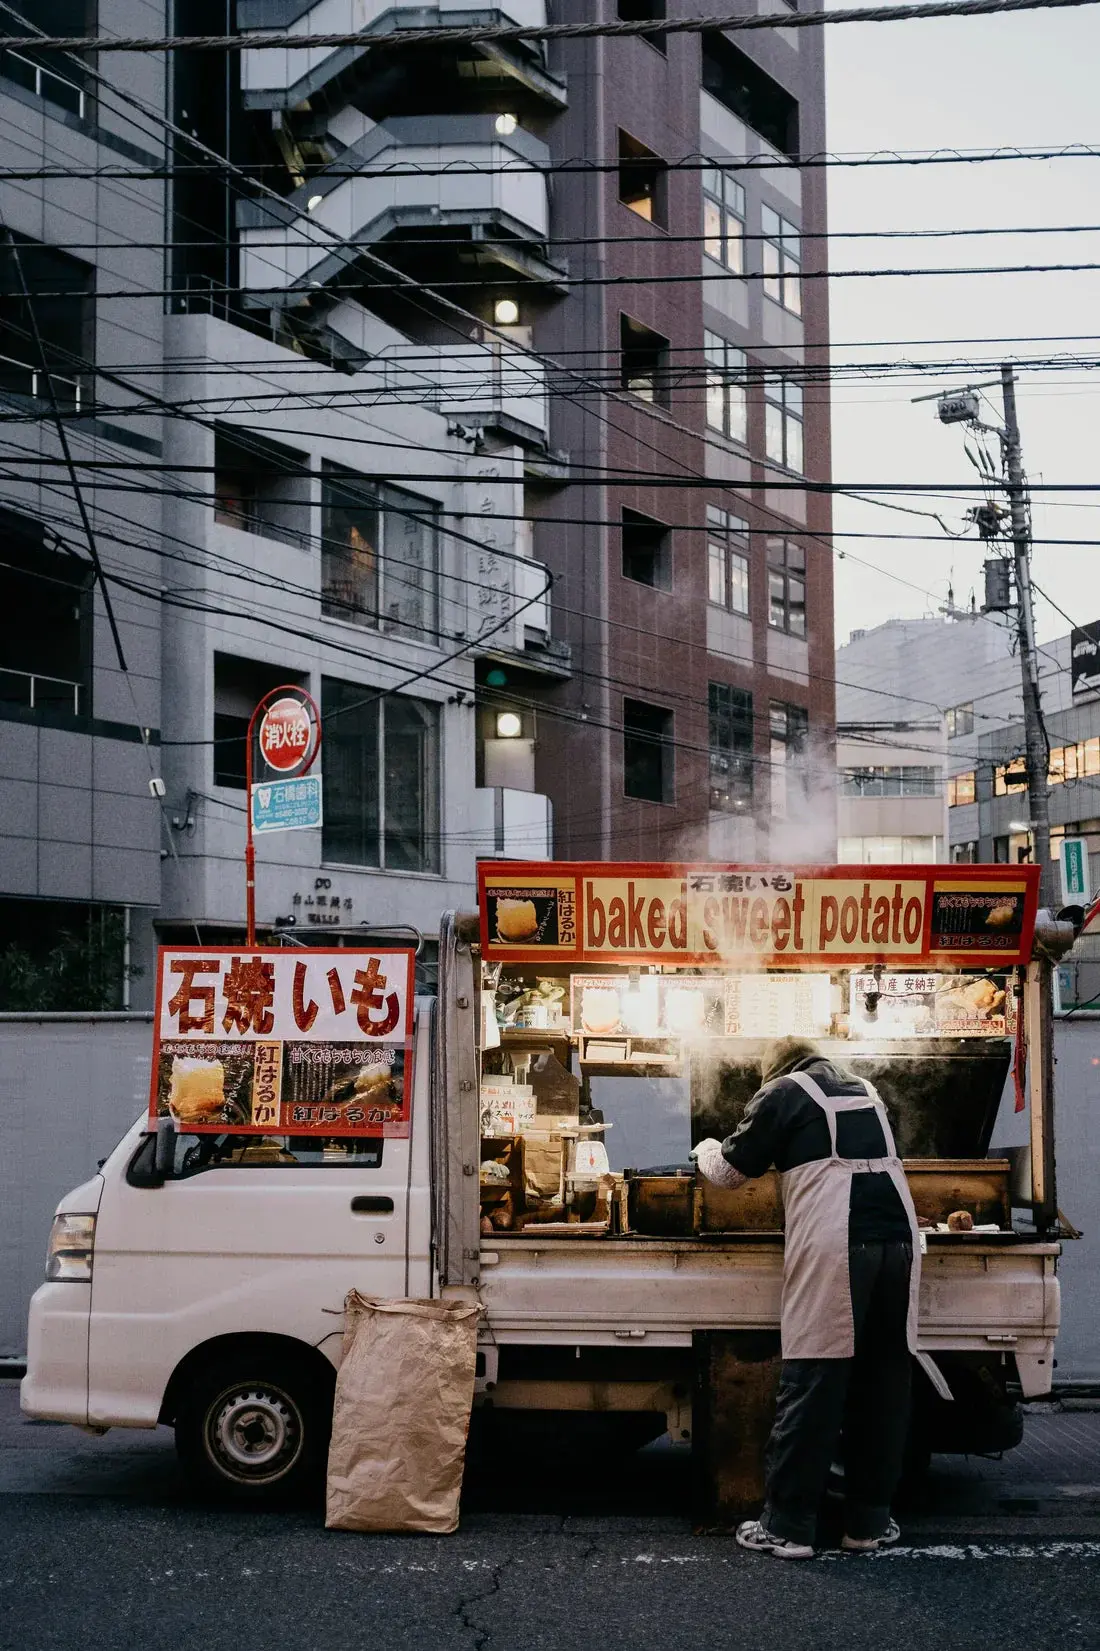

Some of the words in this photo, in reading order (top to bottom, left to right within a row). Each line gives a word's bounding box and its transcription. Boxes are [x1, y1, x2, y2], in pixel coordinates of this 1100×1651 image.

[265, 720, 306, 750] 消火栓
[690, 875, 792, 893] 石焼いも
[558, 890, 576, 943] 紅はるか
[586, 882, 688, 949] baked
[703, 884, 805, 950] sweet
[820, 884, 922, 950] potato
[938, 935, 1013, 947] 紅はるか
[168, 956, 400, 1037] 石焼いも
[855, 977, 898, 992] 種子島産
[904, 977, 936, 992] 安納芋
[291, 1047, 396, 1065] 甘くてもちもちの食感
[254, 1045, 280, 1123] 紅はるか
[292, 1106, 392, 1122] 紅はるか
